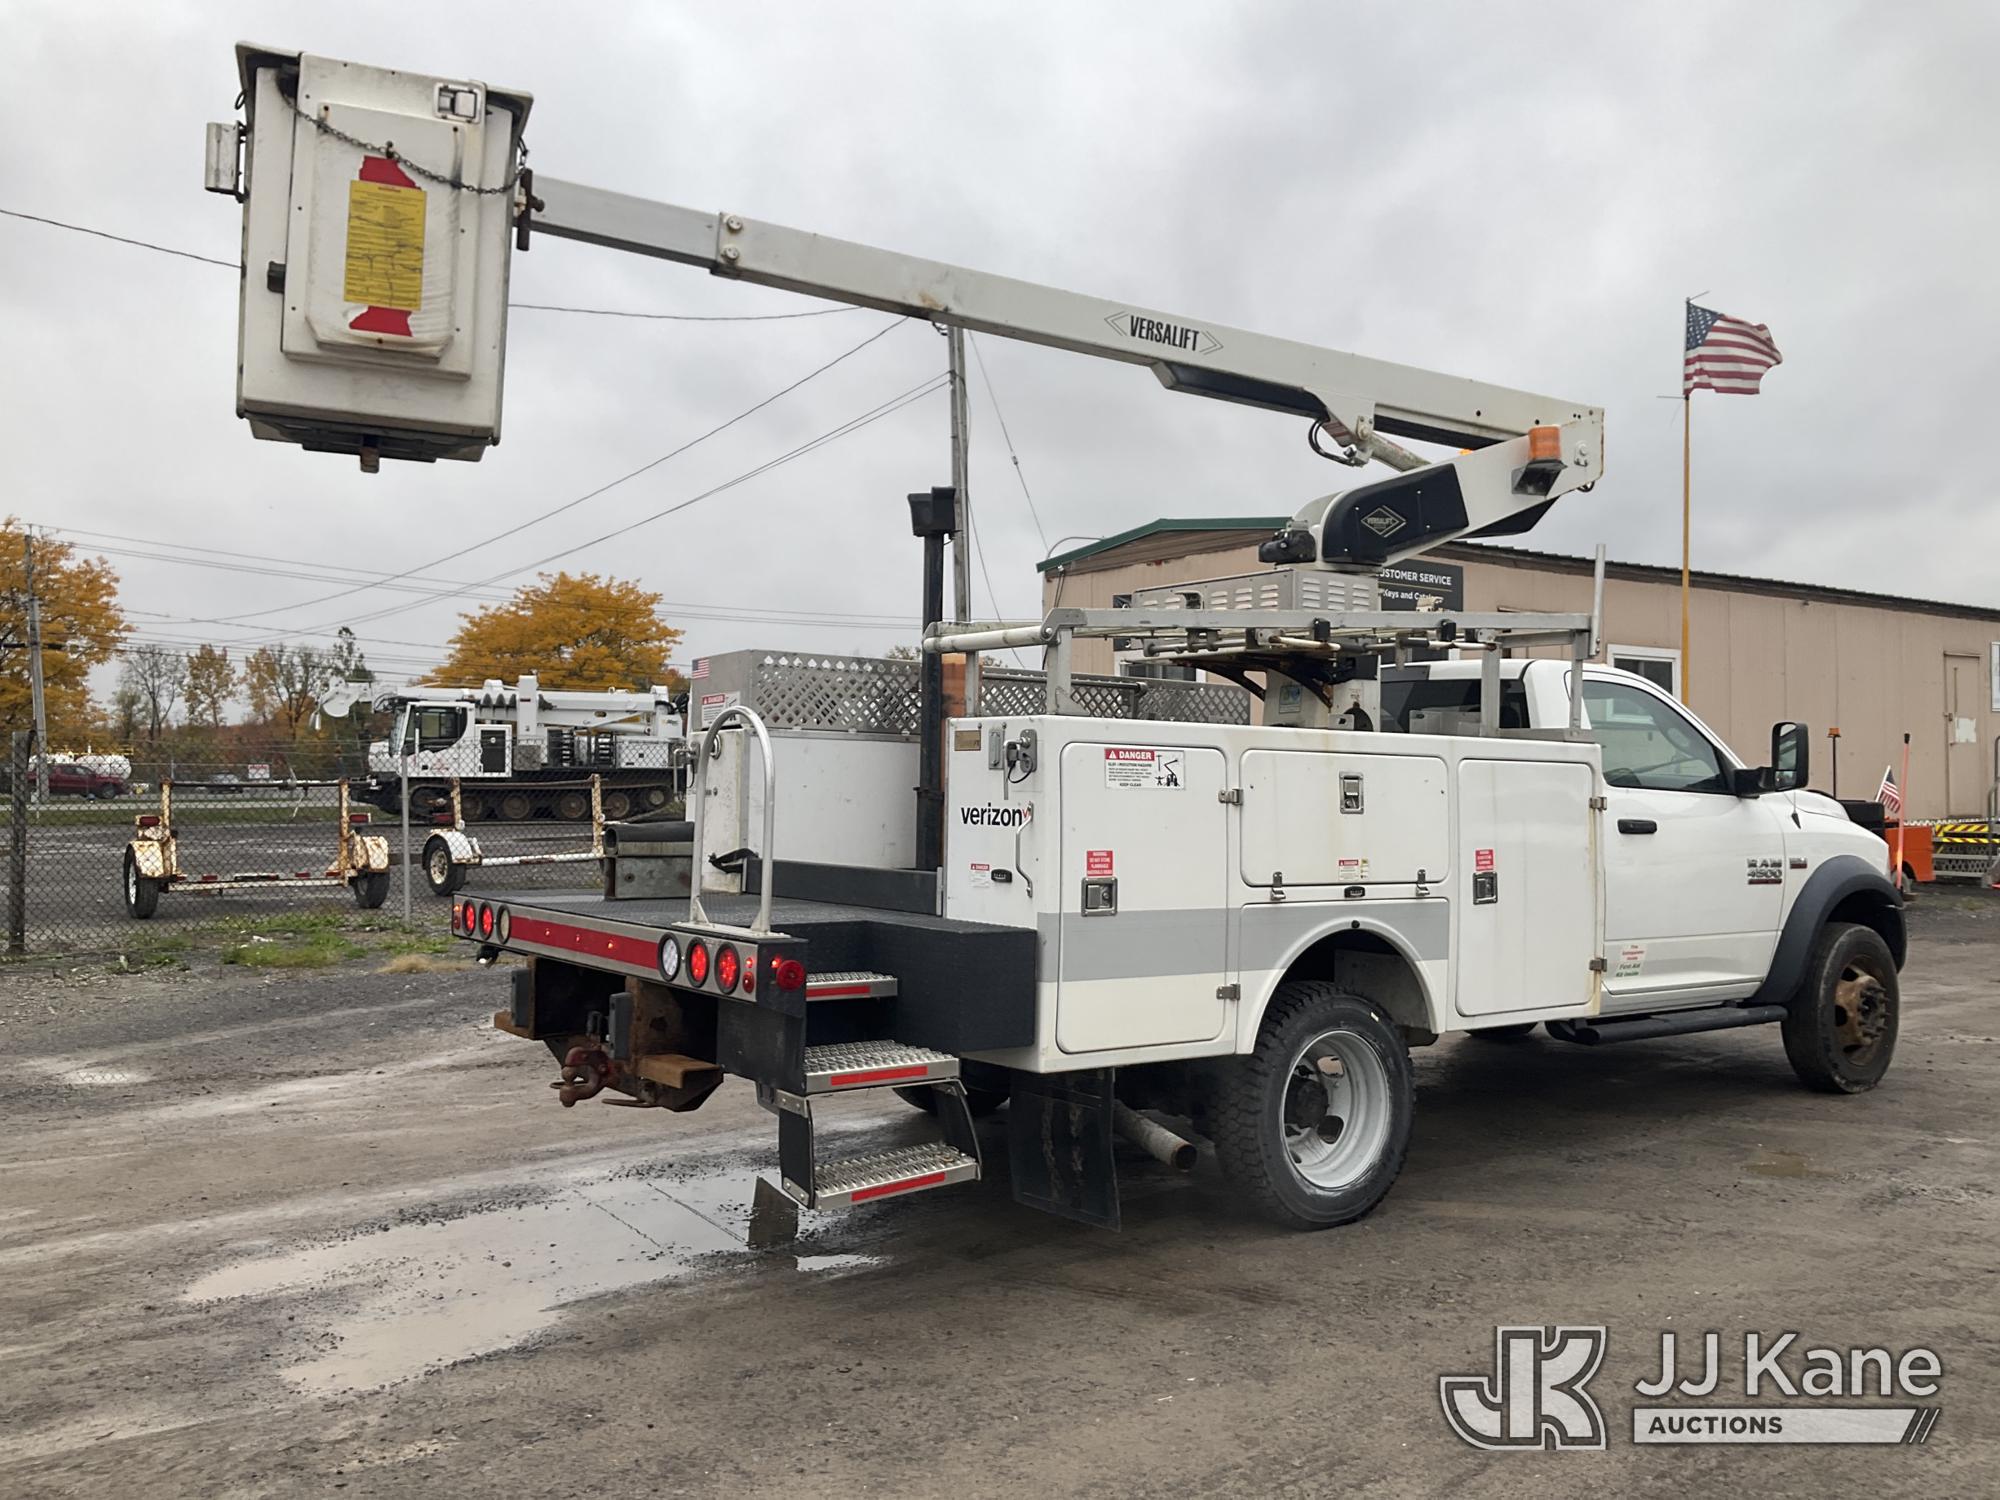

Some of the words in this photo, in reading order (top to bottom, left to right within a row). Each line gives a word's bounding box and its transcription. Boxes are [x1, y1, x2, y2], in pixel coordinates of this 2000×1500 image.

[1129, 314, 1200, 352] VERSALIFT
[1376, 568, 1418, 582] USTOMER
[1419, 572, 1452, 586] SERVICE
[1383, 588, 1400, 600] Keys
[1400, 591, 1414, 600] and
[1118, 750, 1152, 760] DANGER
[960, 802, 1023, 827] verizon
[1746, 858, 1783, 868] RAM
